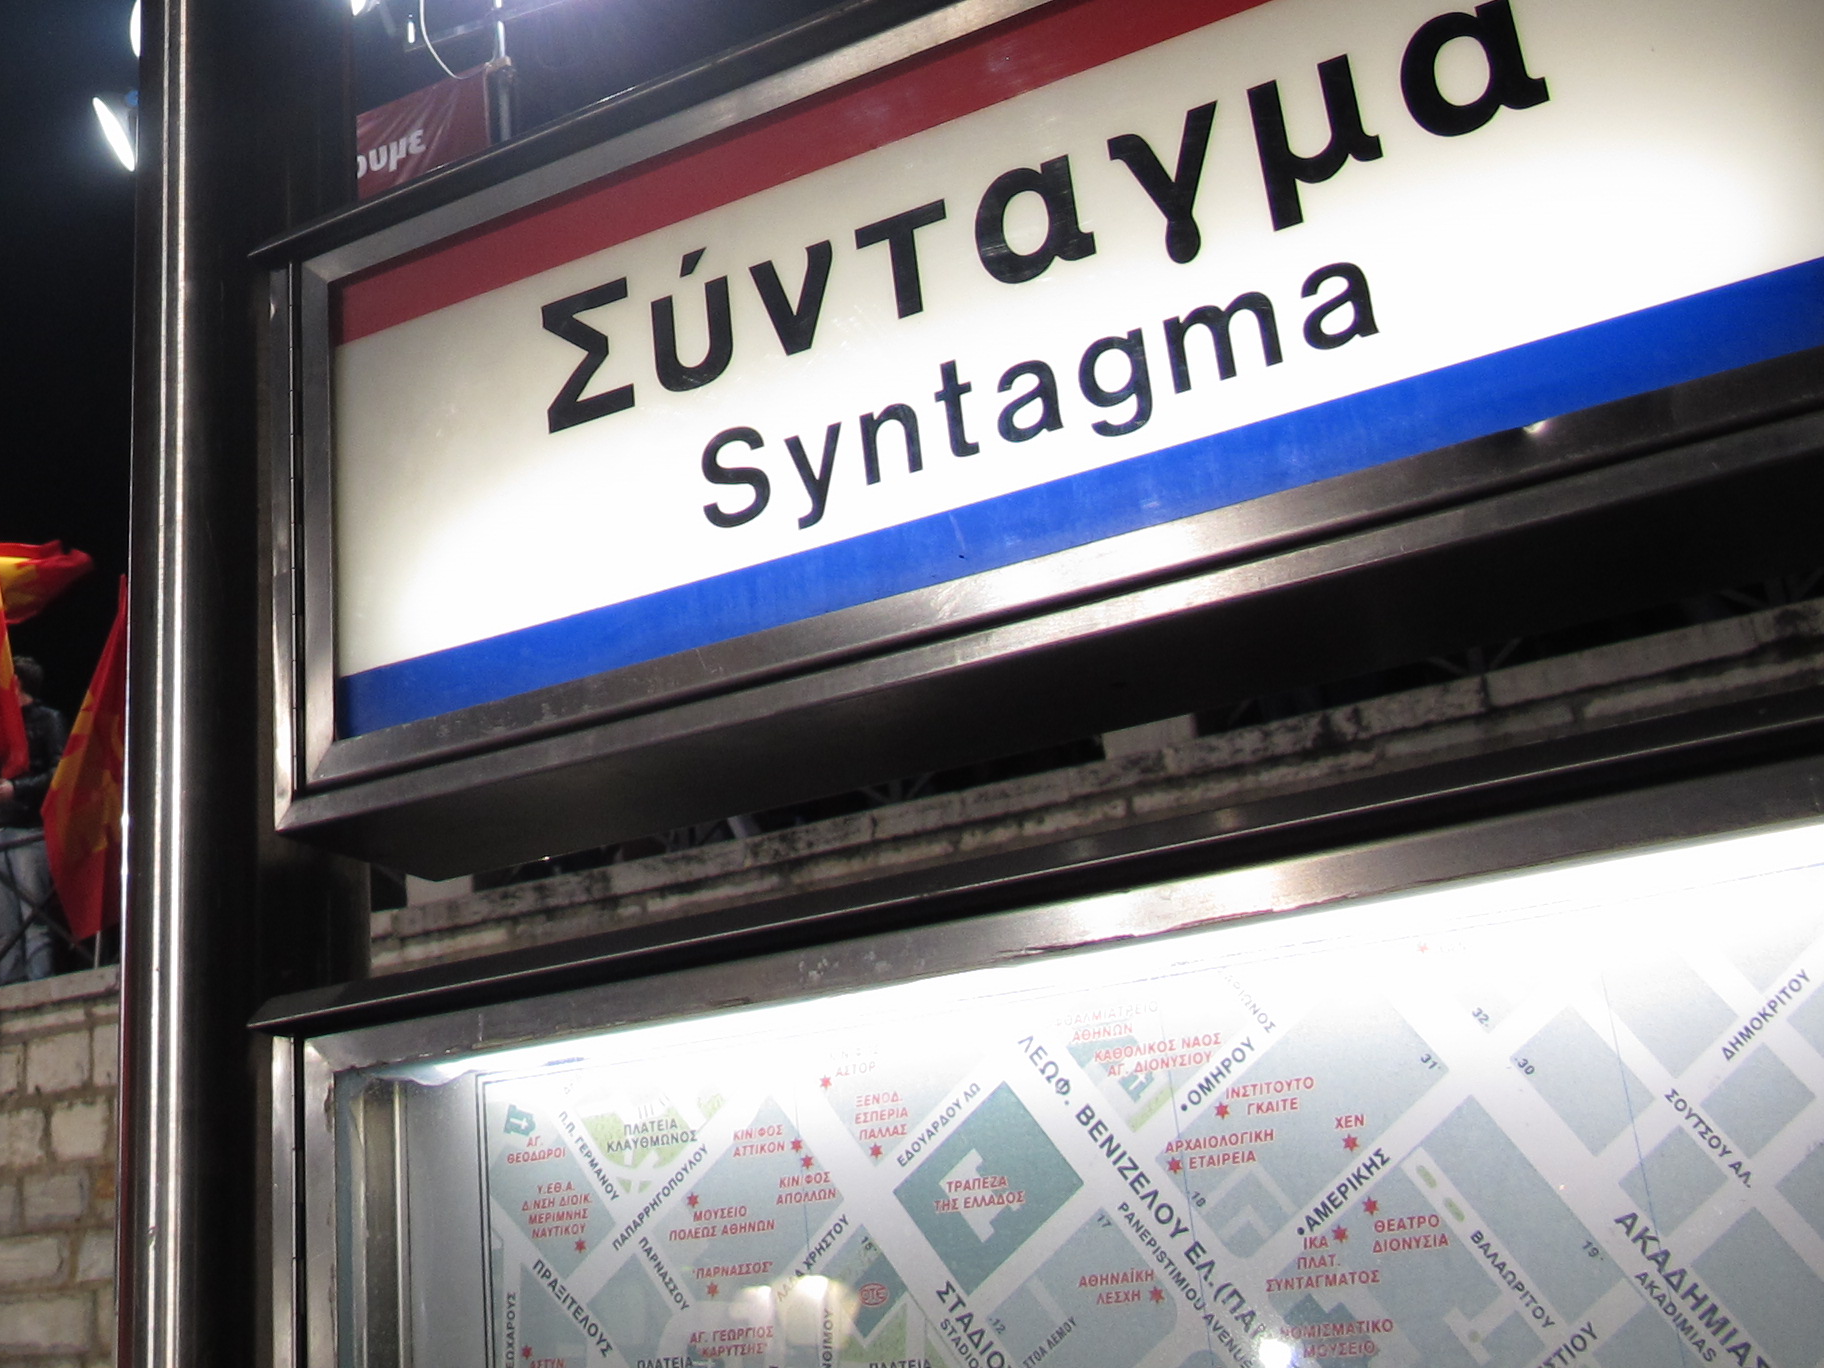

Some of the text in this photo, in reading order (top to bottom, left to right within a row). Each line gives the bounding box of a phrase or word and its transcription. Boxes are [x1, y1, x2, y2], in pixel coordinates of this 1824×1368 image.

[701, 261, 1379, 529] Syntagma
[1721, 969, 1811, 1061] ΔΗΜΟΚΡΙΤΟΥ
[1072, 1023, 1133, 1043] ΑΘΗΝΩΝ
[1094, 1032, 1222, 1063] ΚΑΘΟΛΙΚΟΣ ΝΑΟΣ
[1134, 1051, 1213, 1074] ΔΙΟΝΥΣΙΟΥ
[1187, 1036, 1256, 1106] ΟΜΗΡΟΥ
[1226, 1076, 1315, 1099] ΙΝΣΤΙΤΟΥΤΟ
[855, 1107, 909, 1124] ΕΣΠΕΡΙΑ
[1247, 1097, 1299, 1115] ΓΚΑΙΤΕ
[624, 1118, 678, 1135] ΠΛΑΤΕΙΑ
[859, 1124, 908, 1141] ΠΑΛΛΑΣ
[897, 1082, 981, 1167] ΕΔΟΥΑΡΔΟΥ ΛΩ
[1334, 1114, 1365, 1130] ΧΕΝ
[1664, 1088, 1732, 1159] ΣΟΥΤΣΟΥ
[607, 1130, 698, 1152] ΚΛΑΥΘΜΩΝΟΣ
[733, 1141, 785, 1158] ΑΤΤΙΚΟΝ
[1165, 1129, 1274, 1154] ΑΡΧΑΙΟΛΟΓΙΚΗ
[507, 1147, 566, 1164] ΘΕΟΔΩΡΟΙ
[1018, 1035, 1071, 1106] ΛΕΩΦ.
[1075, 1104, 1189, 1240] ΒΕΝΙΖΕΛΟΥ
[1183, 1240, 1215, 1288] ΕΛ.
[1189, 1150, 1256, 1170] ΕΤΑΙΡΕΙΑ
[574, 1135, 620, 1202] ΓΕΡΜΑΝΟΥ
[946, 1176, 1008, 1193] ΤΡΑΠΕΖΑ
[1304, 1147, 1391, 1232] ΑΜΕΡΙΚΗΣ
[611, 1144, 708, 1251] ΠΑΠΑΡΡΗΓΟΠΟΥΛΟΥ
[776, 1188, 836, 1205] ΑΠΟΛΛΩΝ
[934, 1191, 1025, 1212] ΤΗΣ ΕΛΛΑΔΟΣ
[528, 1208, 588, 1225] ΜΕΡΙΜΝΗΣ
[693, 1205, 747, 1222] ΜΟΥΣΕΙΟ
[1374, 1214, 1440, 1233] ΘΕΑΤΡΟ
[532, 1223, 586, 1239] ΝΑΥΤΙΚΟΥ
[669, 1219, 775, 1241] ΠΟΛΕΩΣ ΑΘΗΝΩΝ
[802, 1213, 849, 1271] ΧΡΗΣΤΟΥ
[1303, 1236, 1329, 1250] ΙΚΑ
[1372, 1233, 1449, 1253] ΔΙΟΝΥΣΙΑ
[1117, 1202, 1206, 1311] PANEPISTIMIOU
[638, 1236, 690, 1311] ΠΑΡΝΑΣΣΟΥ
[1266, 1270, 1380, 1292] ΣΥΝΤΑΓΜΑΤΟΣ
[1470, 1230, 1555, 1328] ΒΑΛΑΩΡΙΤΟΥ
[532, 1259, 613, 1358] ΠΡΑΞΙΤΕΛΟΥΣ
[1096, 1290, 1141, 1305] ΛΕΣΧΗ
[936, 1280, 1012, 1368] ΣΤΑΔΙΟ
[1634, 1271, 1717, 1362] AKADIMIAS
[713, 1326, 774, 1342] ΓΕΩΡΓΙΟΣ
[940, 1318, 983, 1368] STADIO
[1303, 1340, 1376, 1359] ΜΟΥΣΕΙΟ
